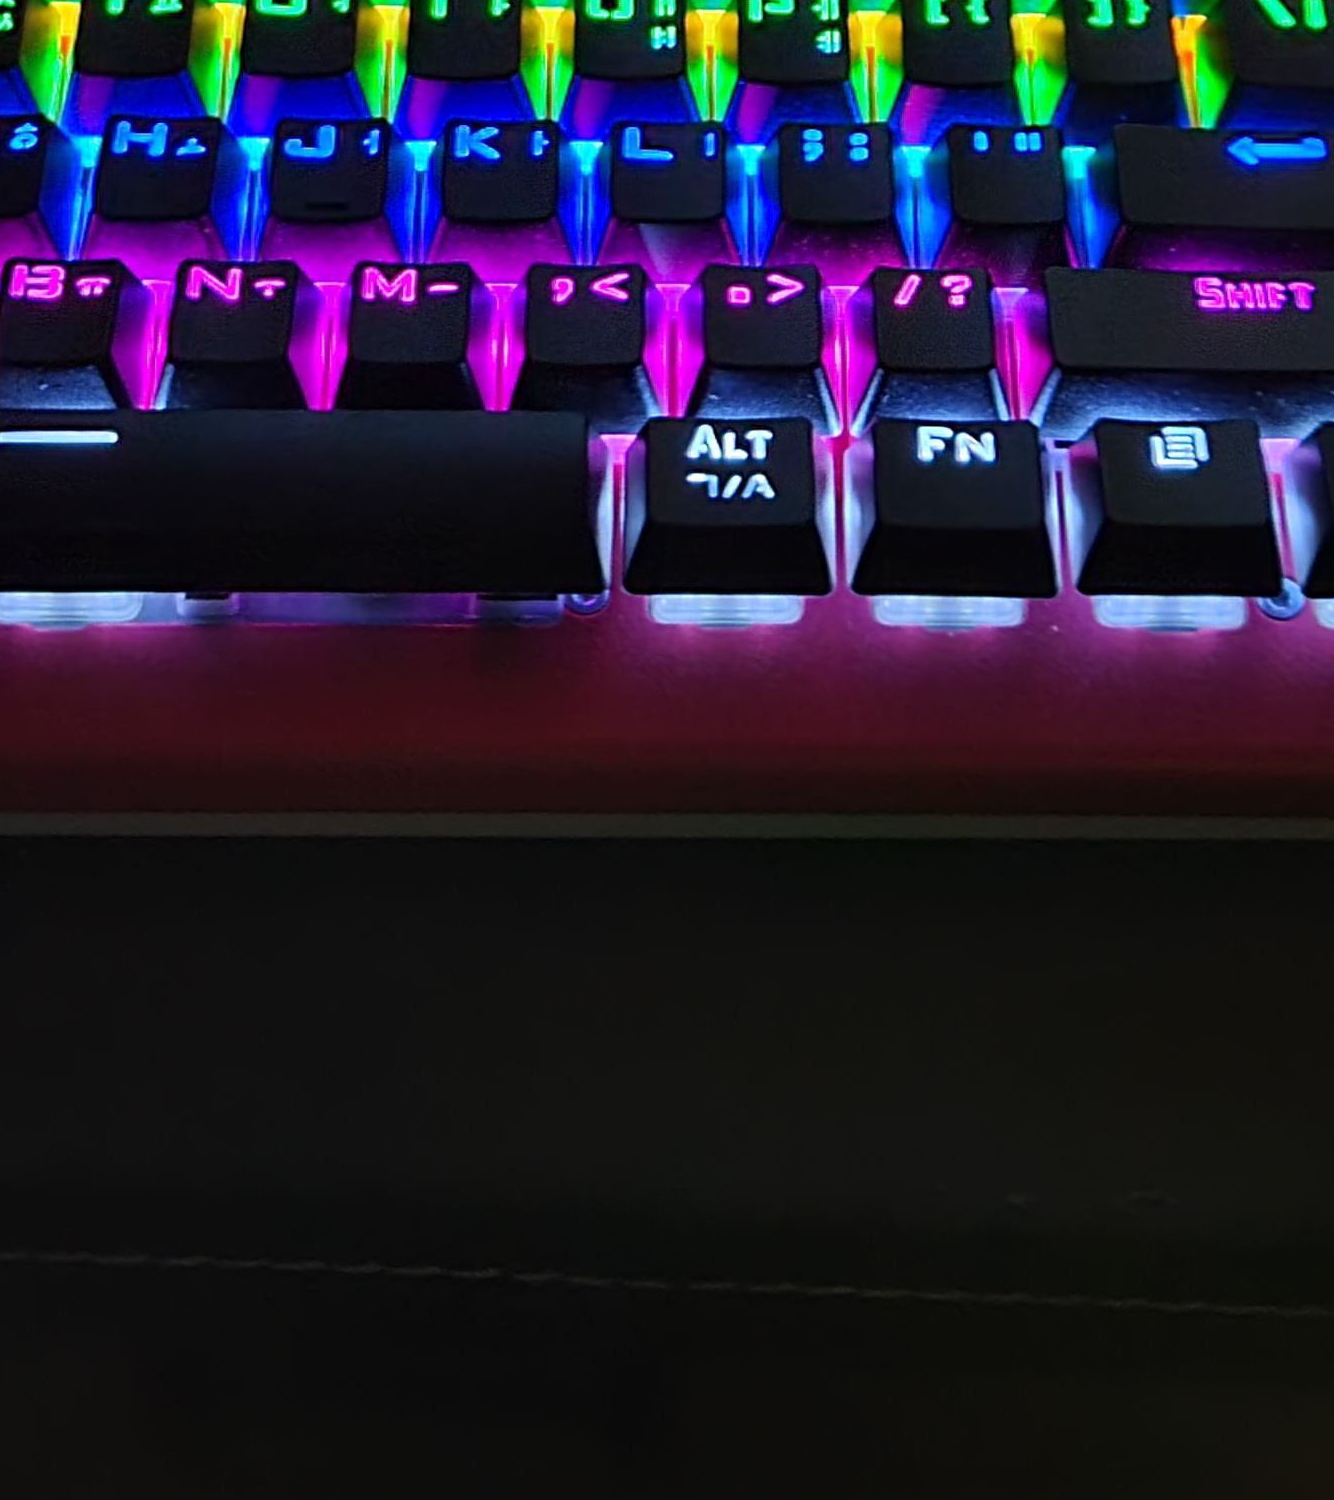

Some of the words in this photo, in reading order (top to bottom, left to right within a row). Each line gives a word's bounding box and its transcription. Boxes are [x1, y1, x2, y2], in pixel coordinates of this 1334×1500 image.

[112, 122, 167, 158] H
[285, 124, 335, 159] J
[456, 126, 501, 159] K
[623, 128, 673, 161] L
[9, 265, 65, 299] B
[186, 266, 243, 300] N
[361, 268, 418, 302] M
